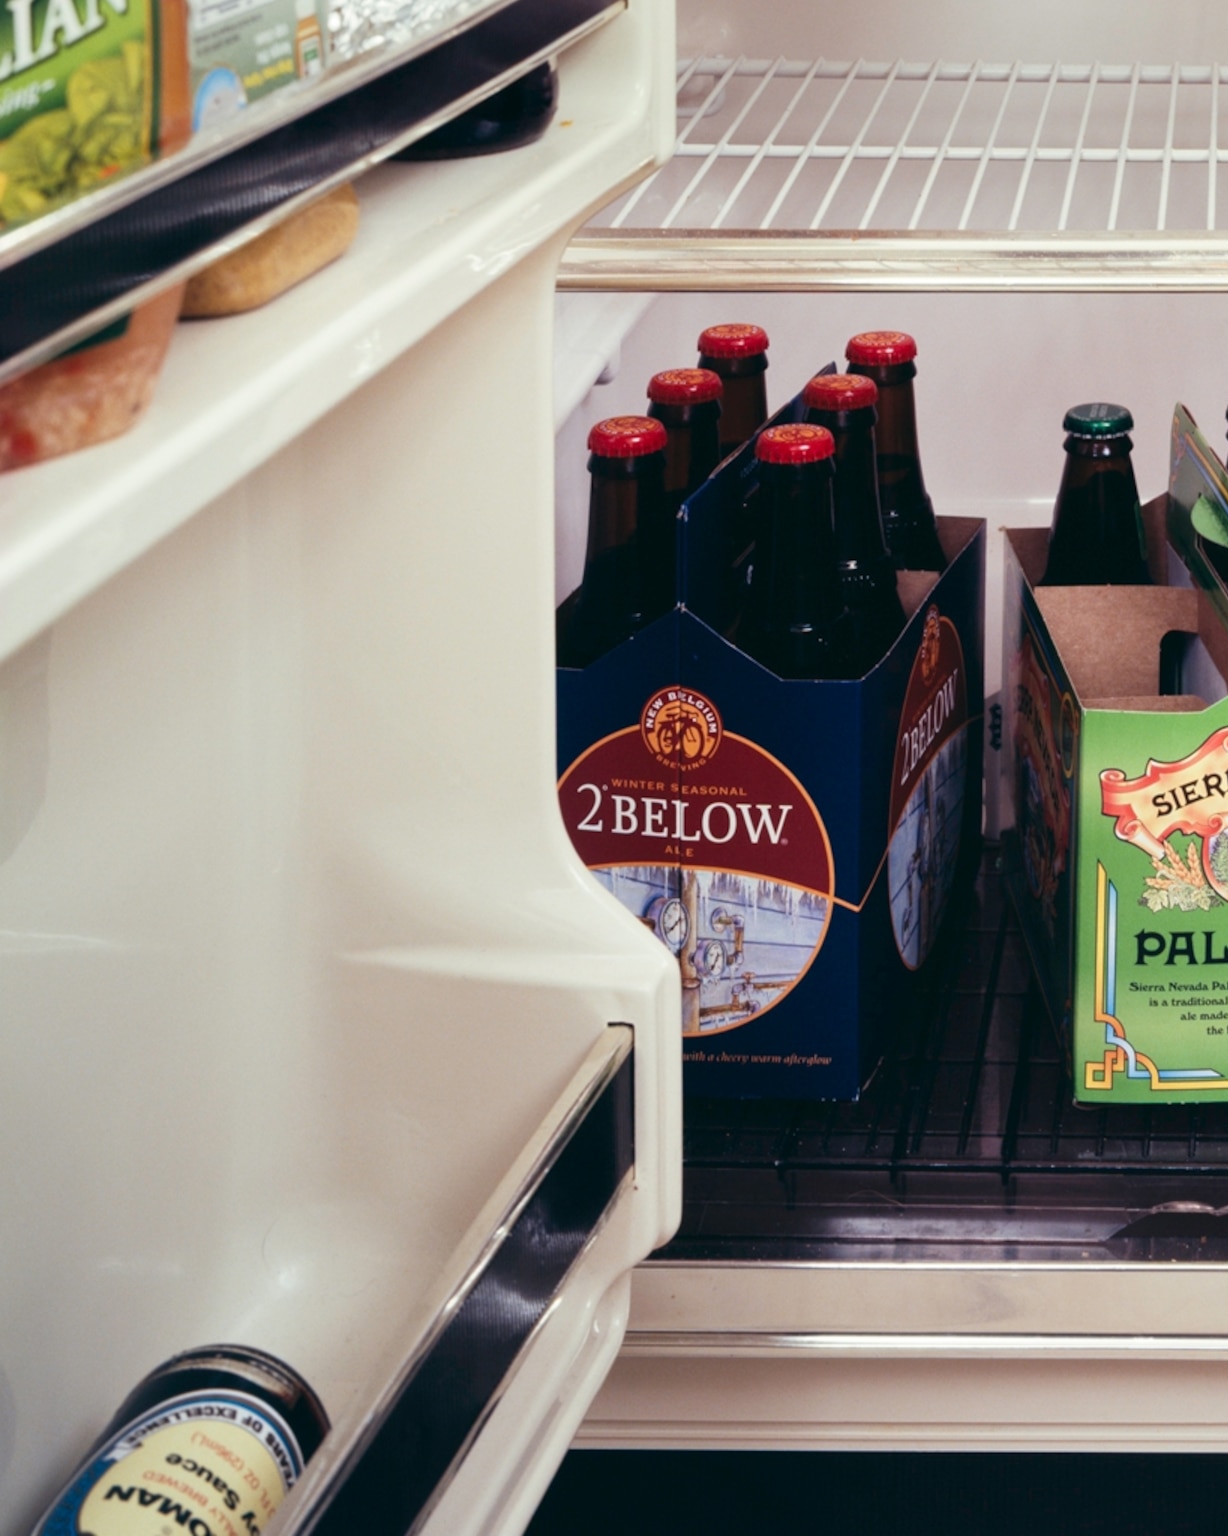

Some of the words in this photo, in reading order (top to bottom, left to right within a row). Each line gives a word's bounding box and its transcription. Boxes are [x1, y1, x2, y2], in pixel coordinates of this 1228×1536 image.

[645, 698, 664, 729] NEW
[667, 691, 718, 734] BELGIUM
[910, 668, 959, 760] BELOW
[656, 754, 707, 772] BREWING
[611, 778, 665, 791] WINTER
[671, 784, 748, 797] SEASONAL
[611, 795, 793, 845] BELOW
[664, 845, 695, 857] ALE
[1129, 981, 1165, 992] Sierra
[1168, 981, 1209, 992] Nevada
[1149, 997, 1158, 1007] is
[1161, 999, 1168, 1007] a
[1171, 996, 1228, 1007] traditional
[1180, 1011, 1197, 1021] ale
[1199, 1010, 1228, 1021] made
[1206, 1025, 1224, 1036] the
[707, 1054, 715, 1063] a
[716, 1051, 750, 1065] cheery
[750, 1055, 782, 1064] warm
[783, 1052, 833, 1068] afterglow
[126, 1404, 240, 1450] EXCELLENCE
[241, 1414, 265, 1435] OF
[142, 1469, 209, 1507] BREWED
[165, 1452, 240, 1511] Sauce
[244, 1470, 260, 1491] OZ
